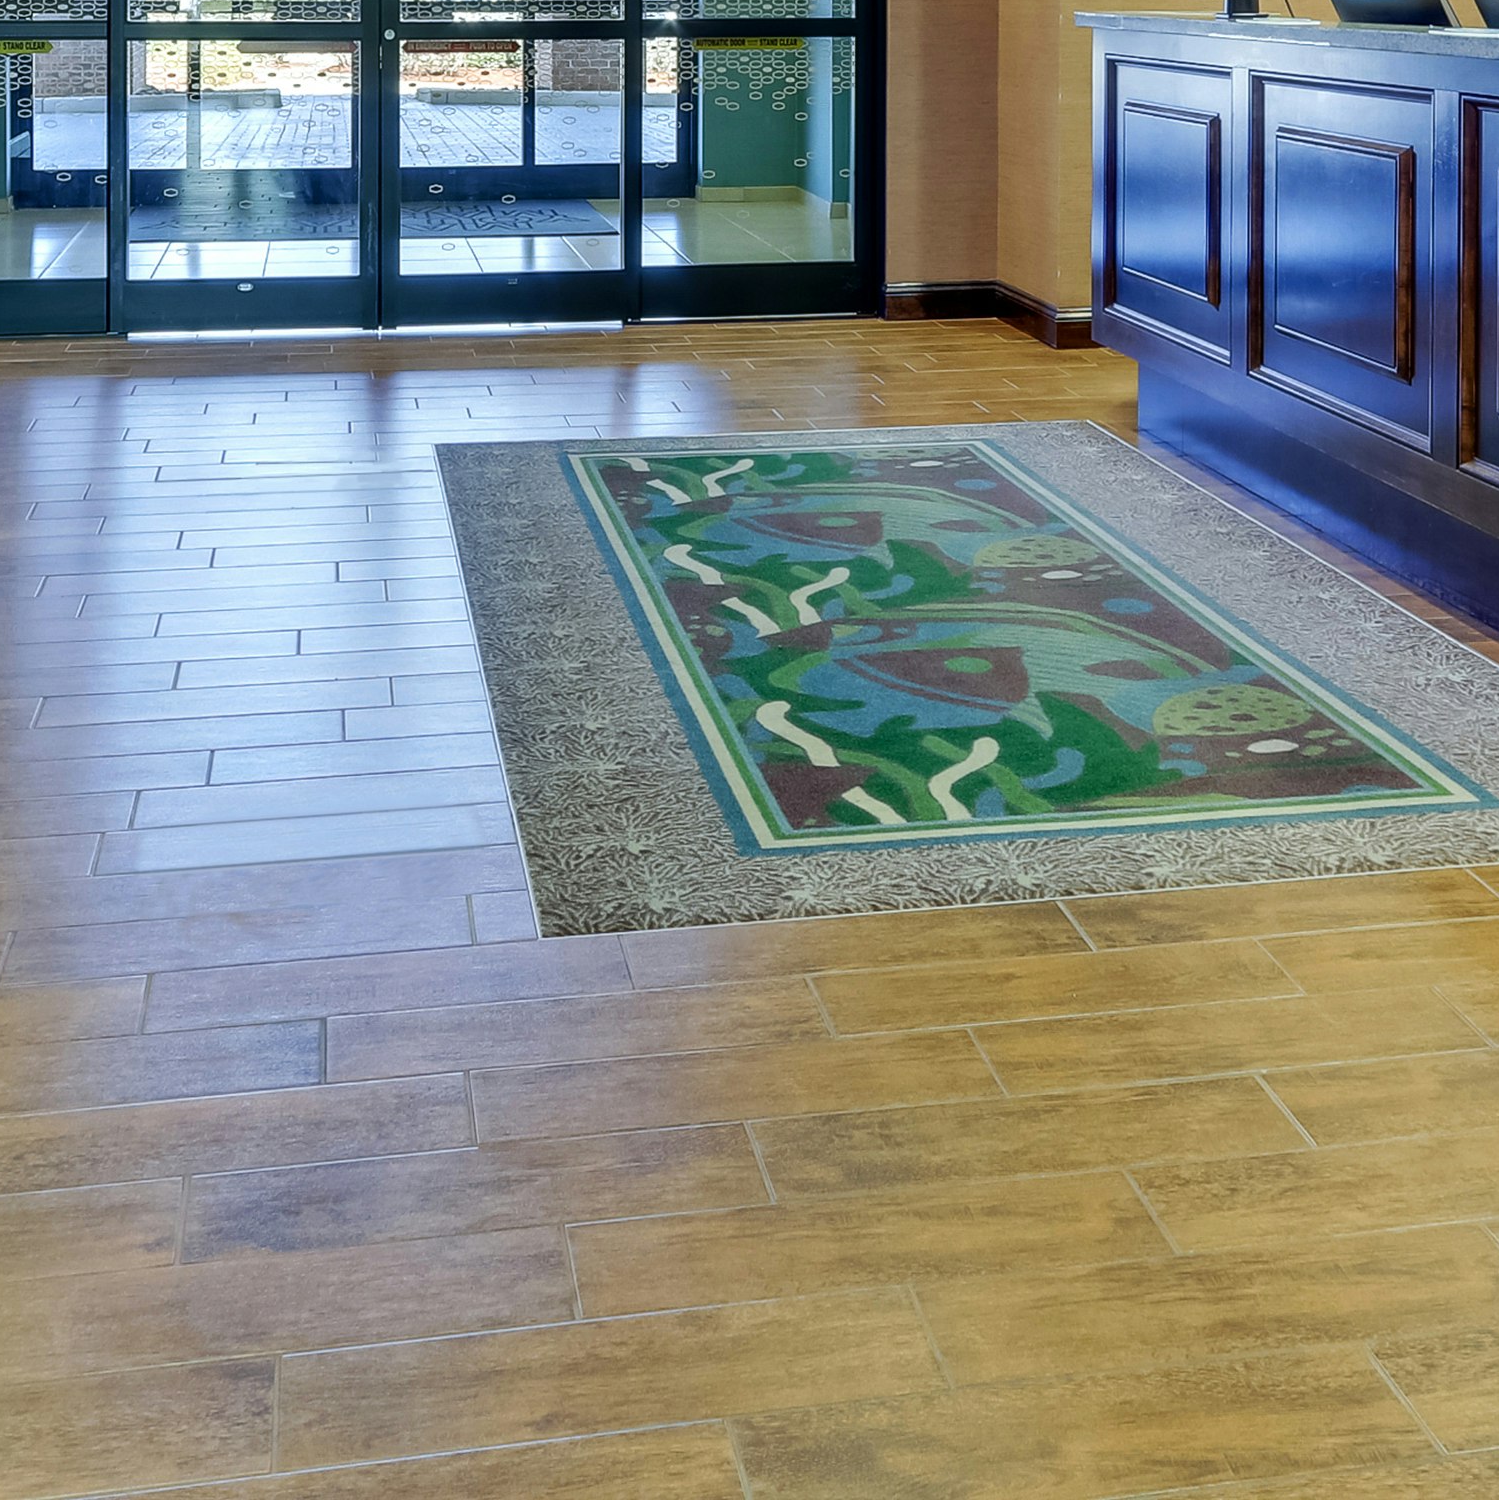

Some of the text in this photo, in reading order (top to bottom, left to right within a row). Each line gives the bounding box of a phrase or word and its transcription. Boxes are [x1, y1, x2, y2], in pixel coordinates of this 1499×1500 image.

[3, 41, 24, 50] STAND
[25, 41, 46, 50] CLEAR
[696, 38, 728, 47] AUTOMATIC
[729, 38, 746, 47] DOOR
[780, 38, 798, 47] CLEAR
